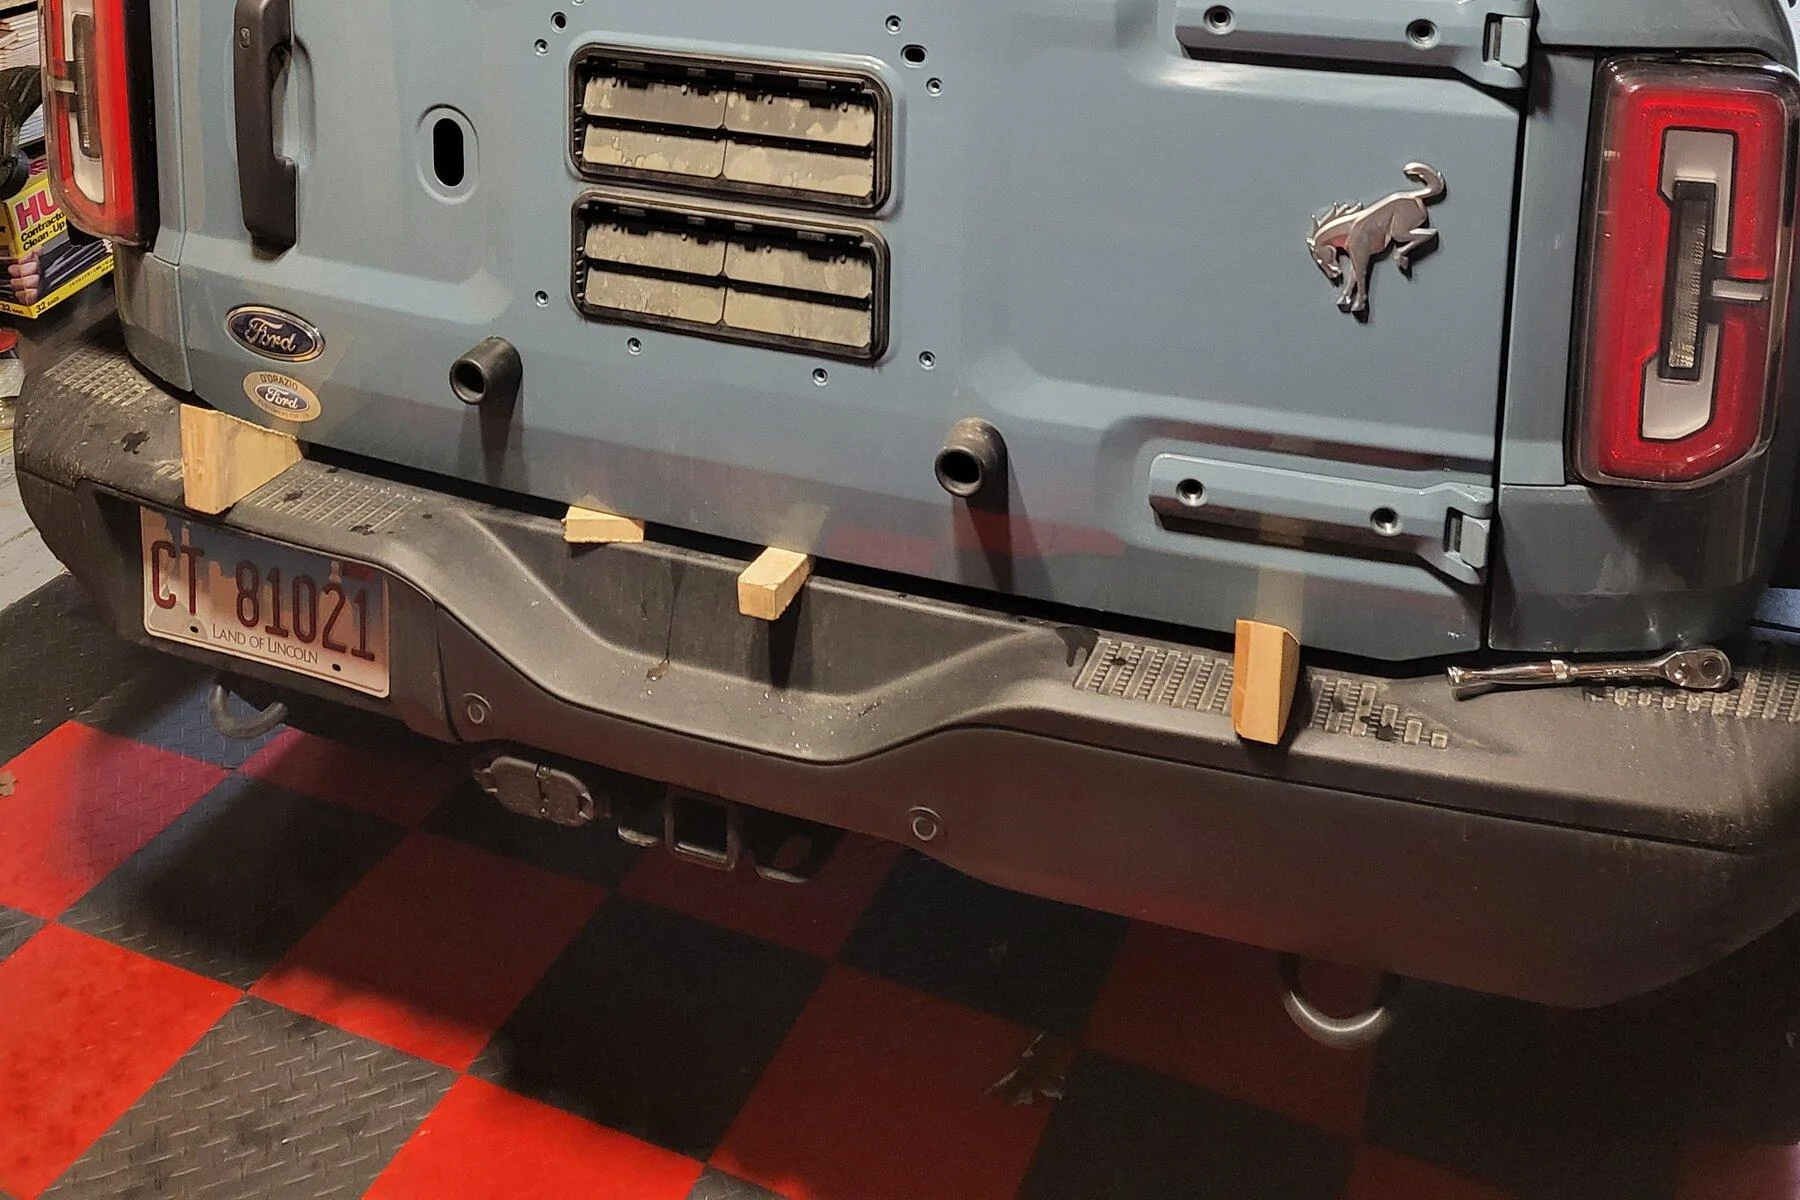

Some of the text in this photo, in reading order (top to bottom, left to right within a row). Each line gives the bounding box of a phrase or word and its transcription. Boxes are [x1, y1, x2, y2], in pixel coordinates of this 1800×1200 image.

[36, 301, 47, 313] 32
[244, 317, 297, 352] Ford
[260, 374, 298, 391] D'ORAZIO
[265, 386, 299, 409] Ford
[151, 540, 375, 662] CT 81021
